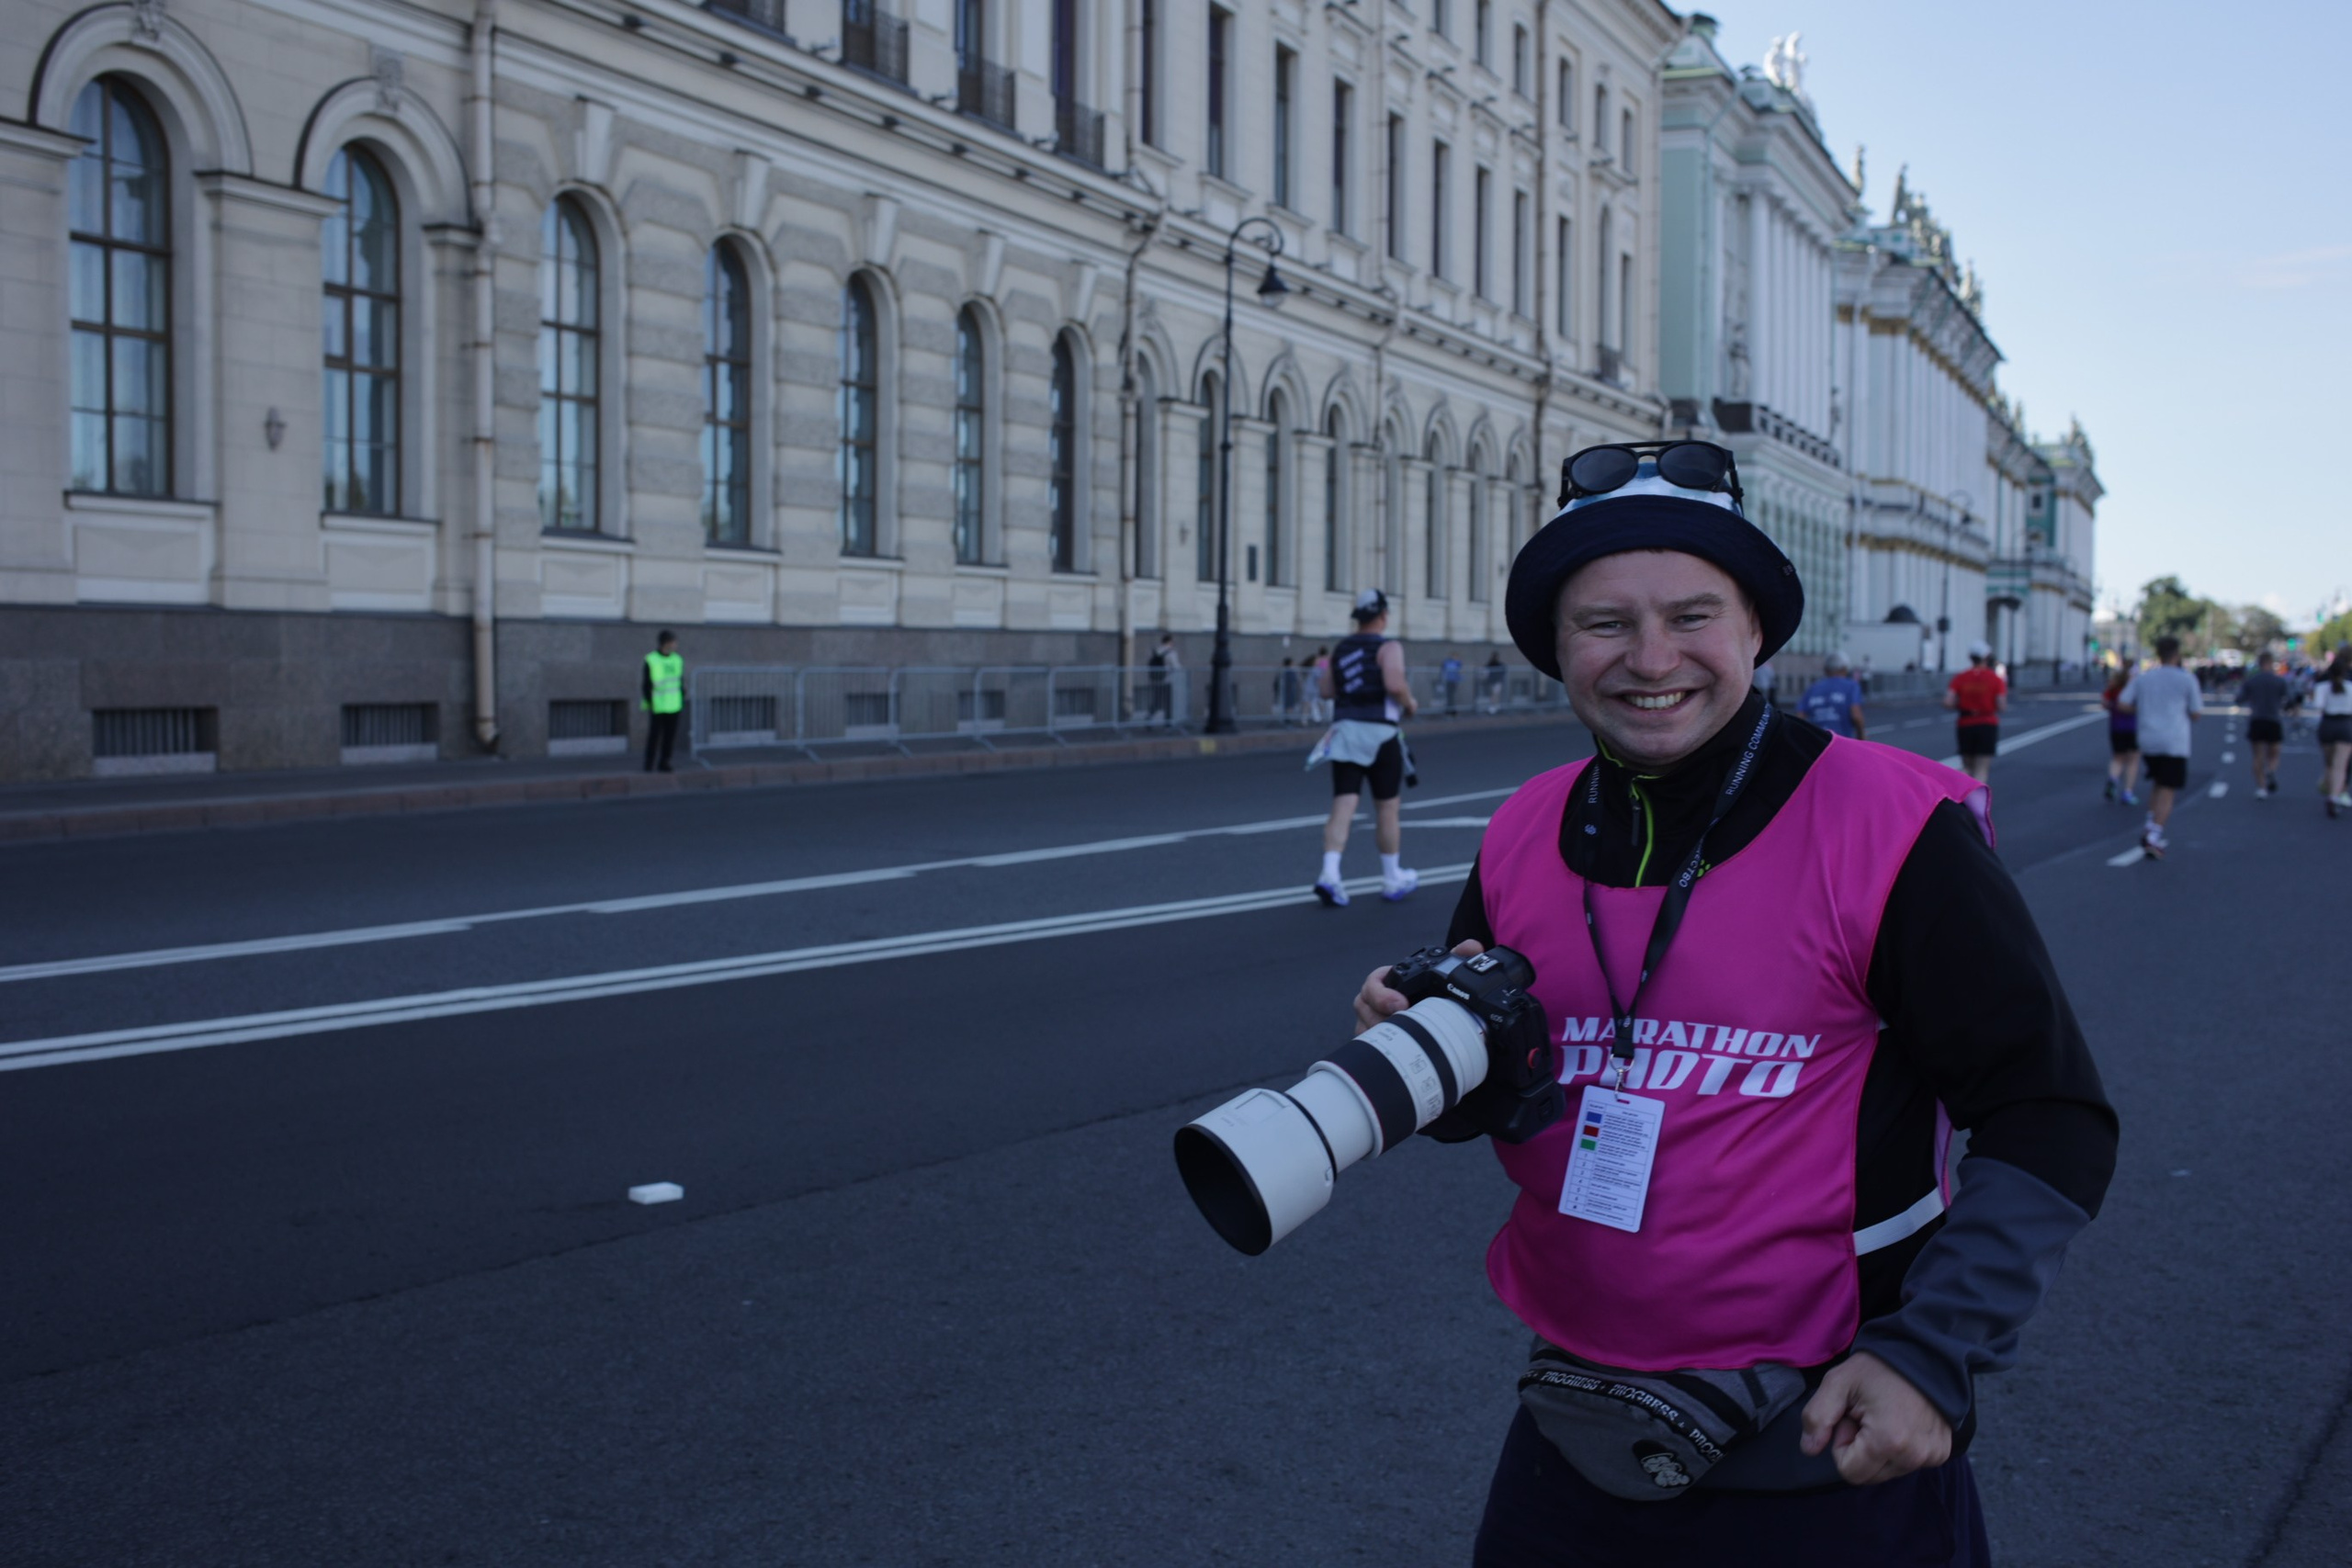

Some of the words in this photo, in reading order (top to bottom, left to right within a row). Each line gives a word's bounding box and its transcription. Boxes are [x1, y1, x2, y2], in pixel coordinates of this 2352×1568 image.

[1588, 765, 1600, 804] RUNNIN
[1725, 750, 1754, 795] RUNNING
[1562, 1017, 1822, 1058] MARATHON
[1557, 1045, 1804, 1098] PHOTO
[1540, 1371, 1601, 1391] PROGRESS
[1609, 1384, 1679, 1421] PROGRESS
